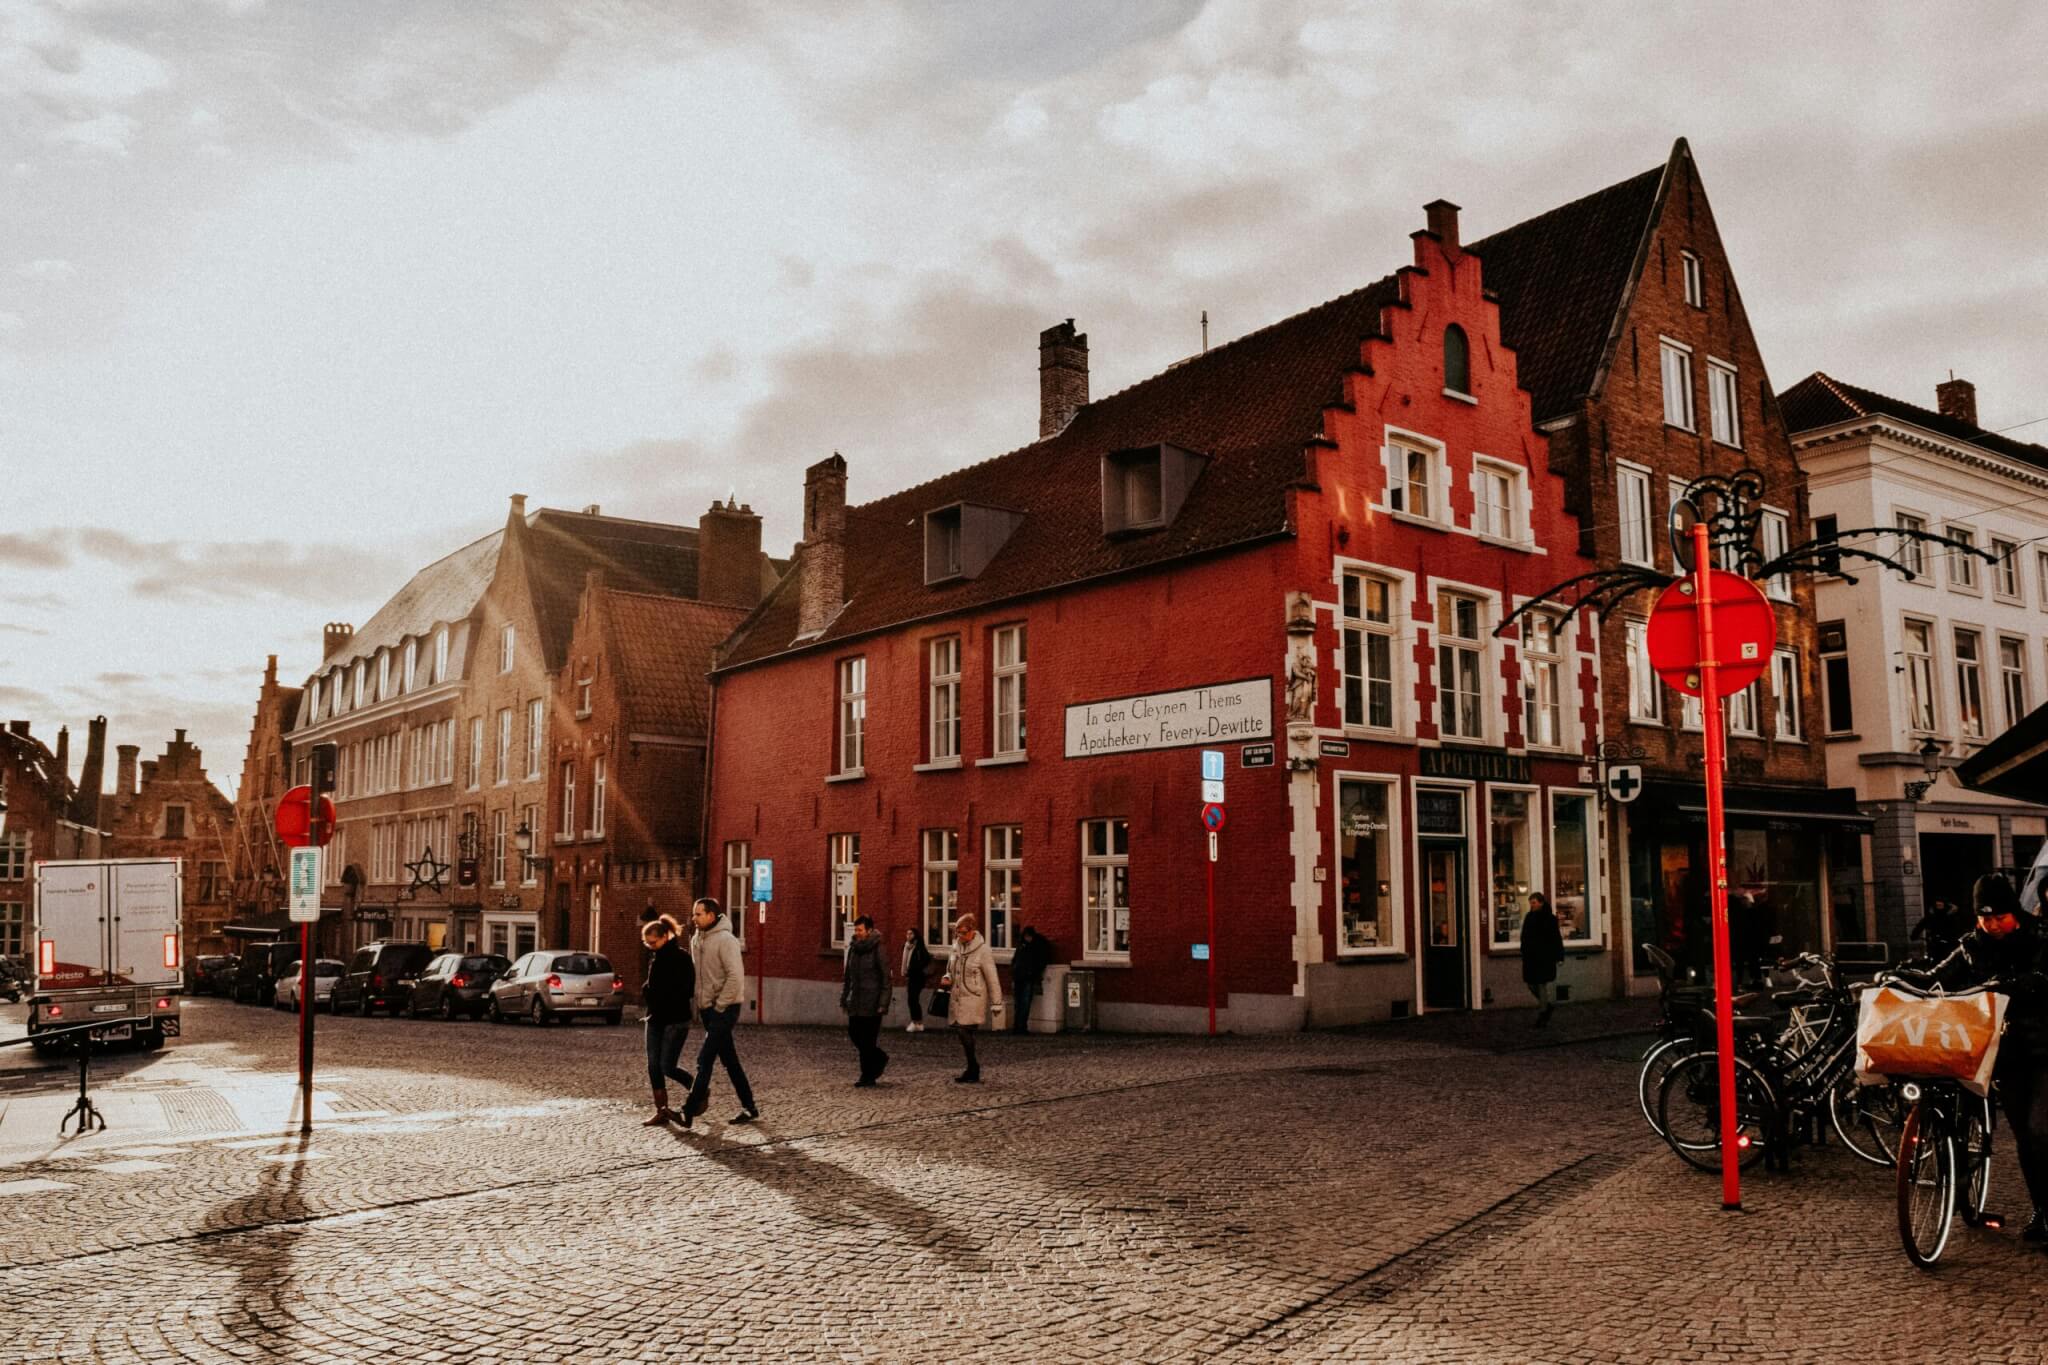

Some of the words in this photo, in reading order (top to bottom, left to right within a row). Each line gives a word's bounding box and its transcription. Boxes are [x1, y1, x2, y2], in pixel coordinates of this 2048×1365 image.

[1086, 707, 1098, 726] In
[1104, 704, 1125, 723] den
[1131, 699, 1187, 720] Cleynen
[1194, 690, 1242, 710] Thems
[1079, 727, 1151, 754] Apothekery
[1160, 716, 1263, 743] Fevery-Dewitte
[1429, 752, 1530, 781] APOTHEEK
